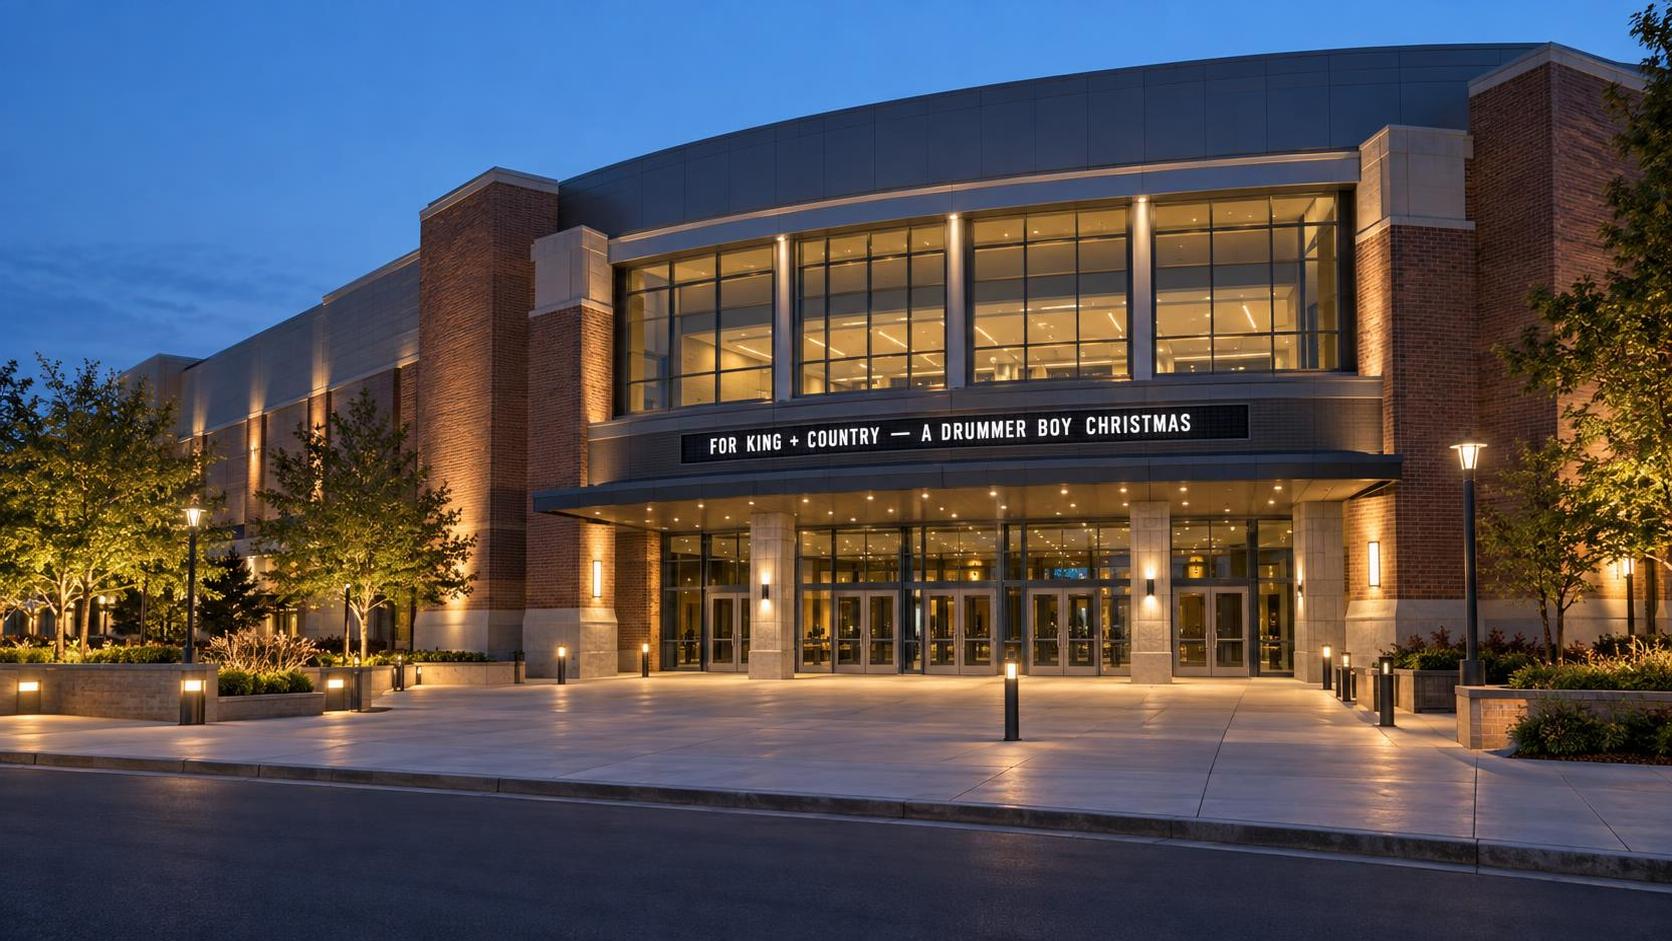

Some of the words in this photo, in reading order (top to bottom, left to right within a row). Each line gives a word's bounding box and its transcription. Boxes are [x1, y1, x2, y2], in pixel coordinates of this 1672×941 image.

[709, 437, 738, 456] FOR
[746, 433, 782, 453] KING
[788, 434, 799, 447] +
[807, 426, 880, 448] COUNTRY
[921, 423, 933, 442] A
[941, 419, 1027, 441] DRUMMER
[1037, 417, 1073, 437] BOY
[1085, 413, 1192, 435] CHRISTMAS
